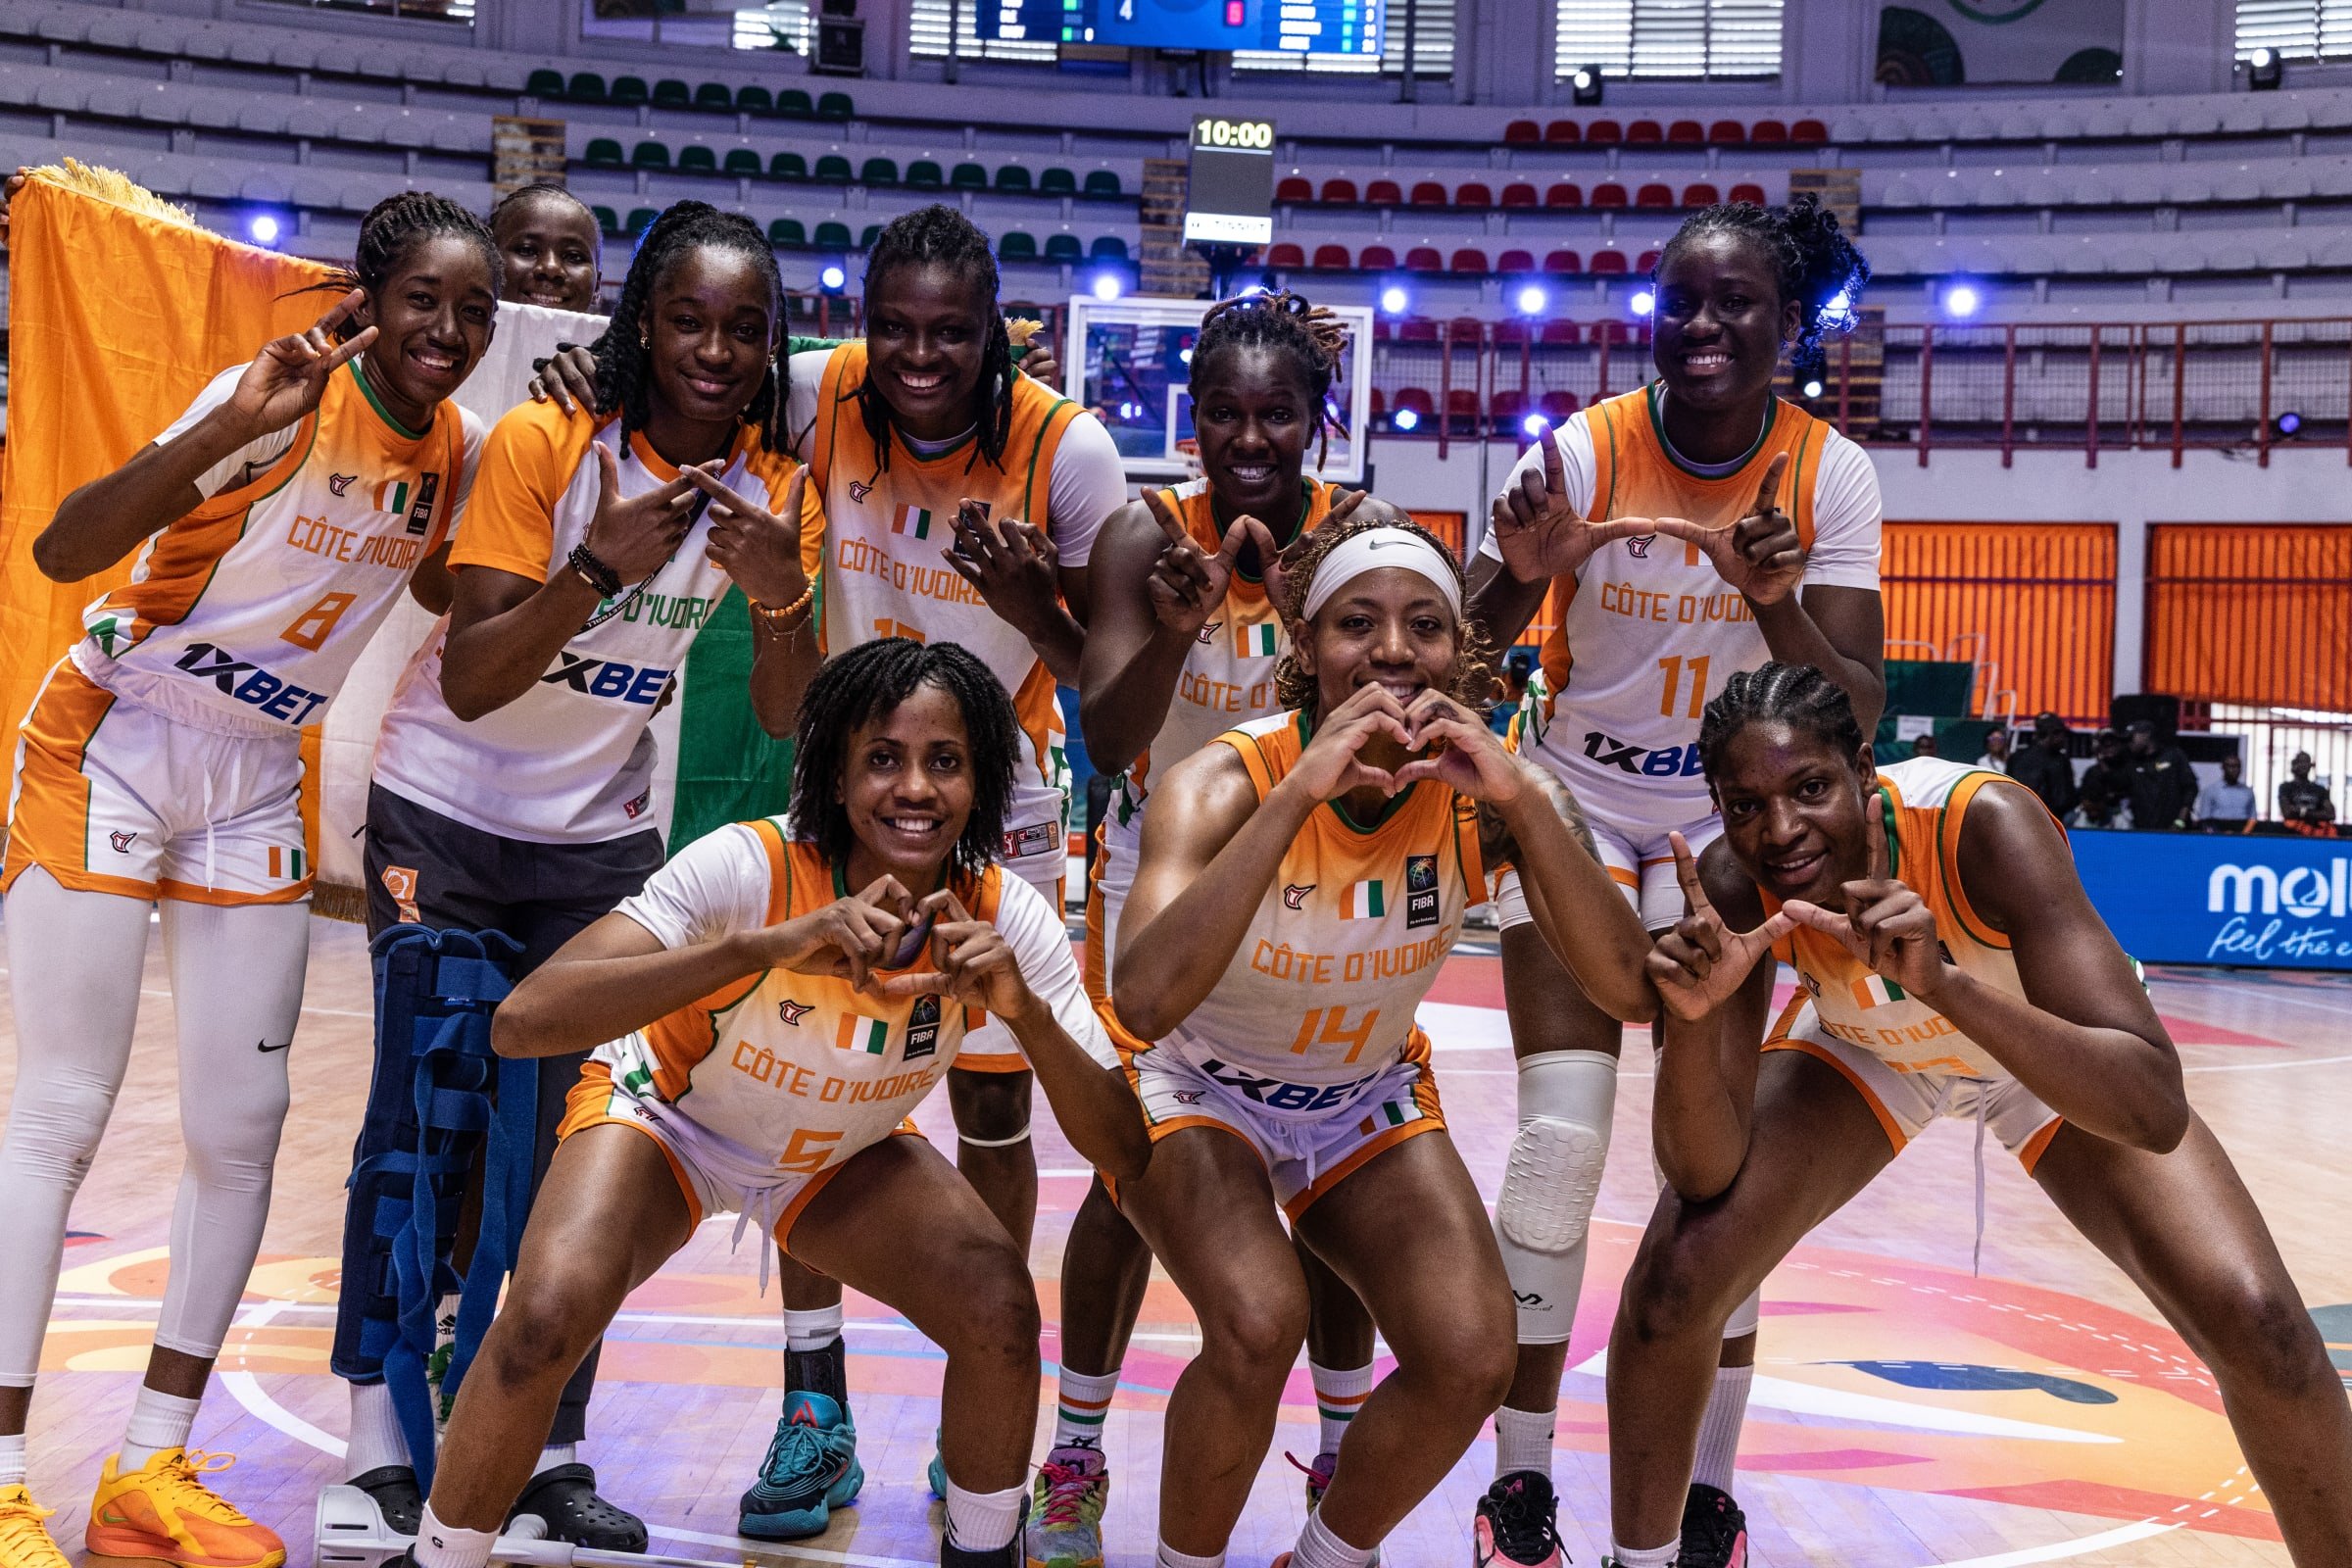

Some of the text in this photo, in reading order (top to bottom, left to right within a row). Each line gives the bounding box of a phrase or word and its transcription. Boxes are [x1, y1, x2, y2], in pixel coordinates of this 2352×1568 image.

[1198, 119, 1272, 148] 10:00
[286, 514, 359, 564] CÔTE
[838, 535, 890, 582] CÔTE
[279, 591, 358, 653] 8
[1600, 581, 1754, 624] CÔTE D'IVOI
[173, 642, 329, 725] 1XBET
[540, 651, 676, 705] XBE
[1179, 669, 1243, 712] CÔTE
[1658, 654, 1710, 719] 11
[1583, 730, 1705, 777] 1XBE
[1411, 894, 1434, 911] FIBA
[2208, 858, 2352, 918] mol
[1250, 923, 1453, 984] CÔTE D'IVOIRE
[2206, 915, 2282, 960] feel
[2278, 925, 2335, 958] the
[910, 1029, 934, 1045] FIBA
[1290, 1004, 1380, 1064] 14
[1877, 1015, 1958, 1046] D'IVO
[731, 1039, 941, 1104] CÔTE D'IVOIRE
[774, 1128, 846, 1174] 5
